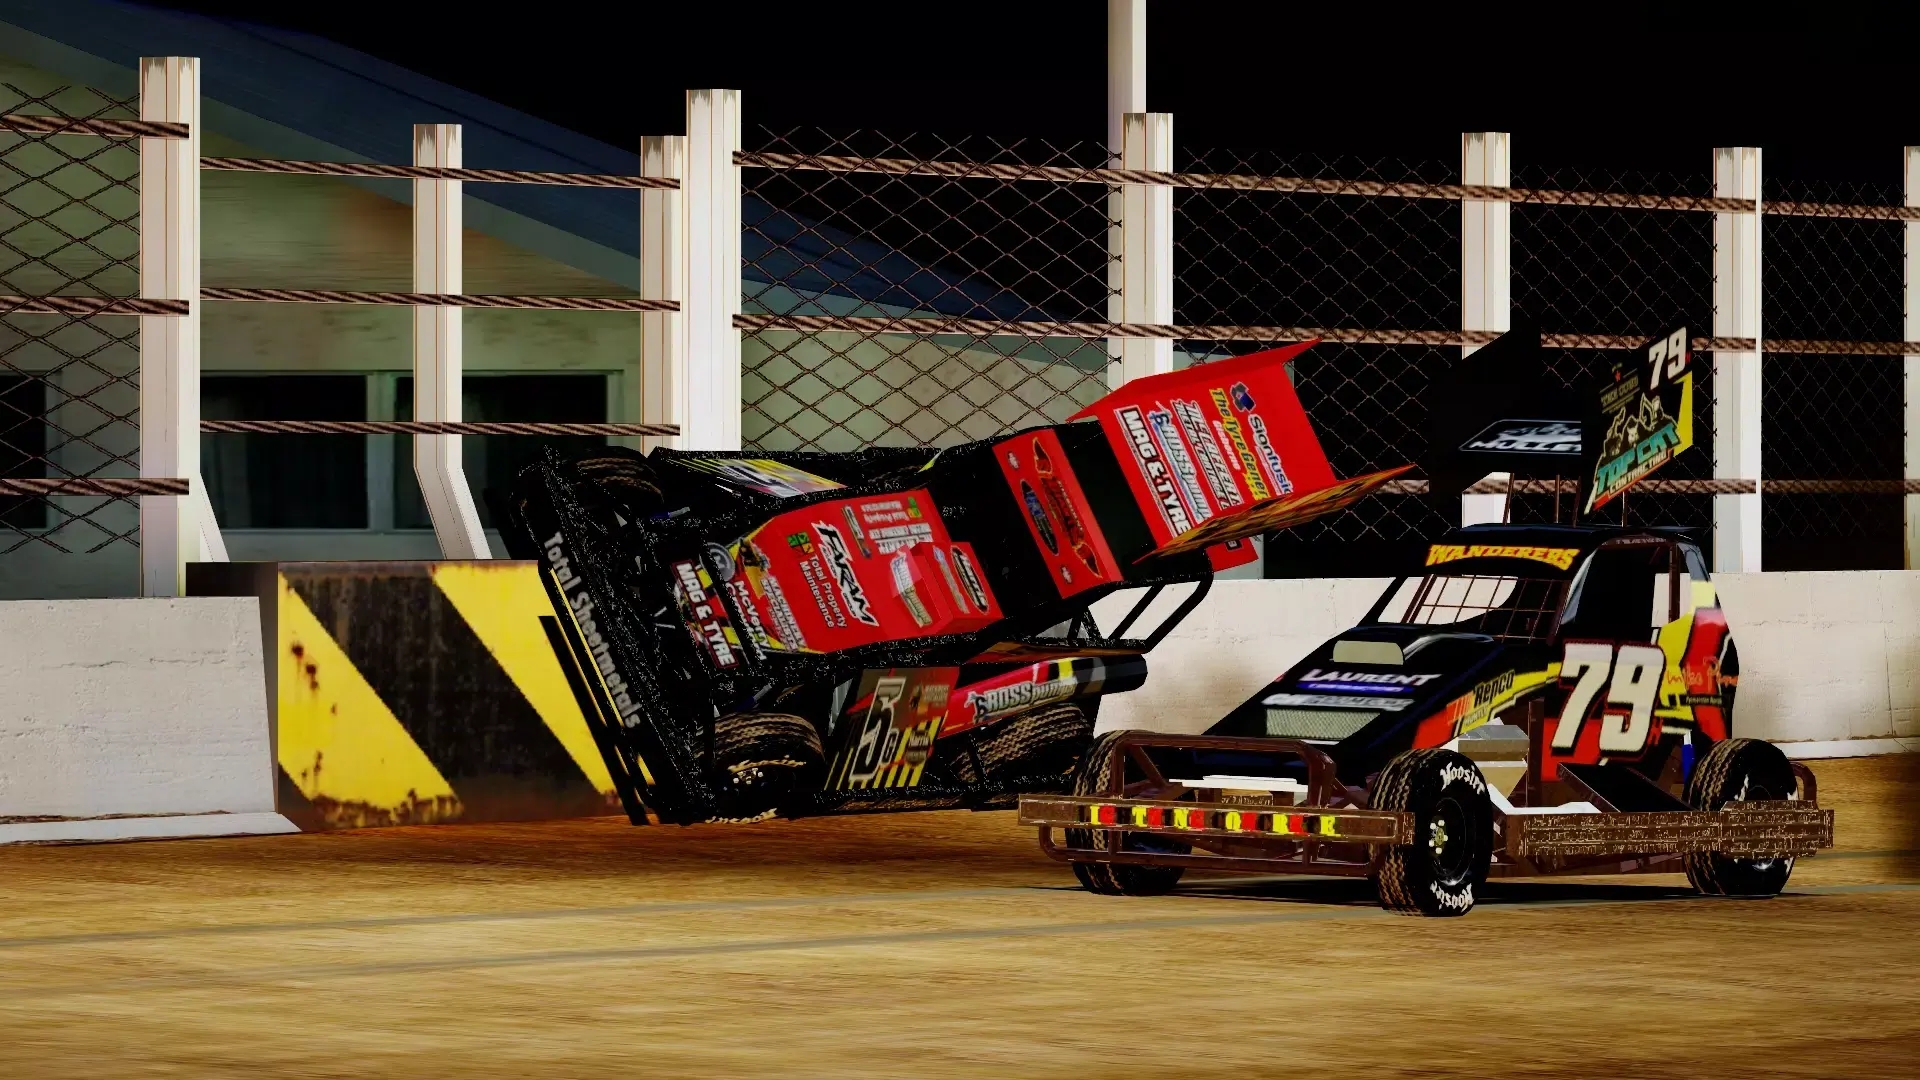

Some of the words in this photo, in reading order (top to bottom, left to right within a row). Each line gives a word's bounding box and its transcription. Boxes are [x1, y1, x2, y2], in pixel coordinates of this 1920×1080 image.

[1649, 326, 1687, 390] 79
[1210, 389, 1232, 417] The
[1226, 418, 1246, 449] Tyre
[1122, 409, 1158, 461] MAG
[1146, 458, 1166, 481] &
[1156, 479, 1192, 535] TYRE
[1597, 456, 1634, 494] TOP
[1637, 423, 1679, 463] CAT
[1609, 451, 1667, 494] CONTRACTING
[676, 561, 706, 605] MAG
[818, 526, 877, 624] FARAM
[1426, 545, 1580, 570] WANDERERS
[695, 603, 714, 621] &
[735, 580, 771, 648] McVerry
[799, 560, 836, 628] Maintenance
[808, 553, 827, 581] Total
[820, 581, 849, 628] Property
[542, 531, 582, 591] Total
[568, 590, 643, 730] Sheetmetals
[703, 620, 736, 667] TYRE
[1300, 668, 1442, 686] LAURENT
[1474, 670, 1515, 708] Repco
[1552, 642, 1664, 752] 79
[1439, 761, 1486, 795] Hoosier
[1430, 881, 1474, 912] Hoosier
